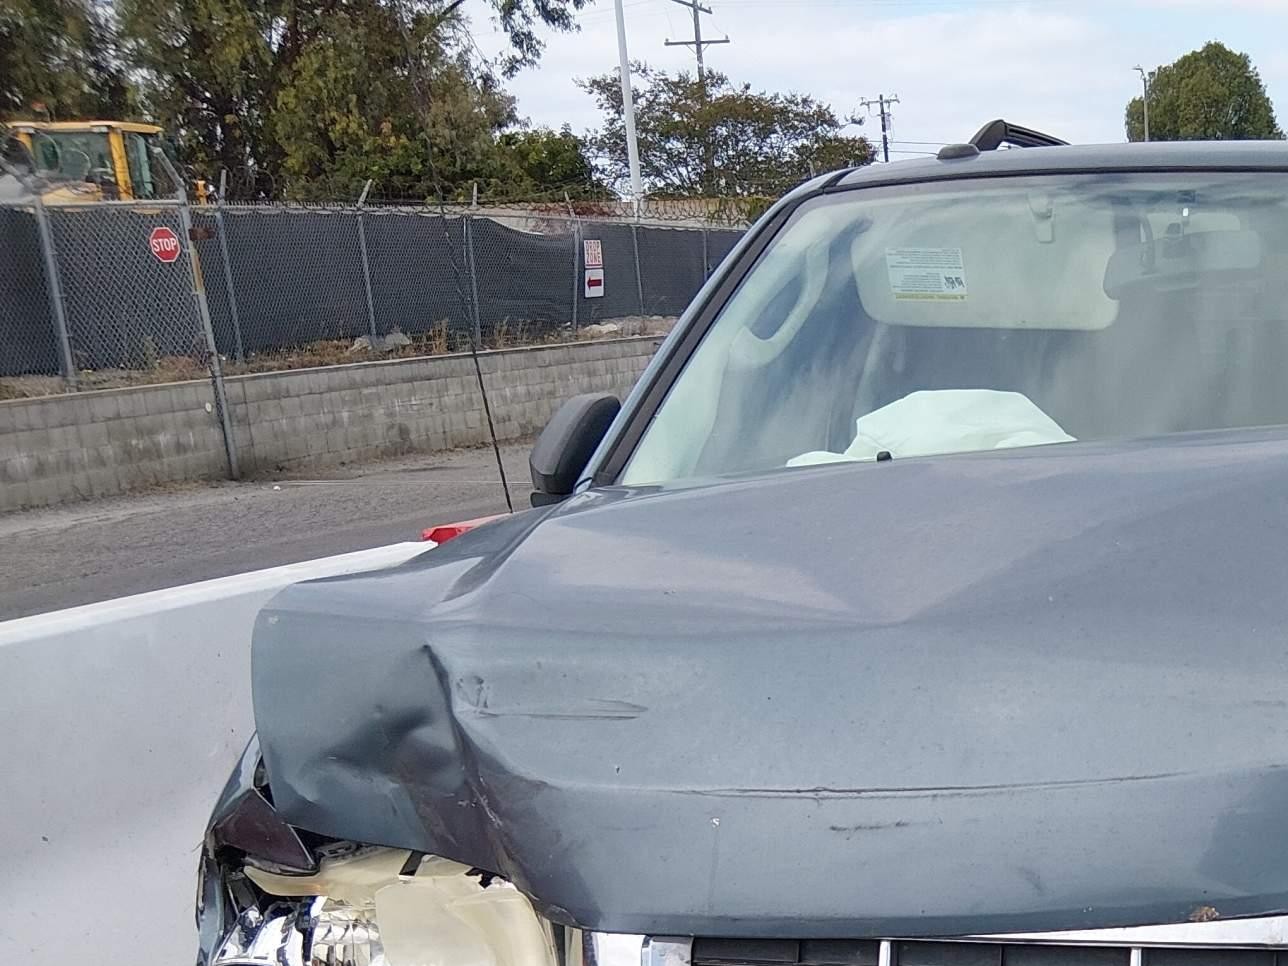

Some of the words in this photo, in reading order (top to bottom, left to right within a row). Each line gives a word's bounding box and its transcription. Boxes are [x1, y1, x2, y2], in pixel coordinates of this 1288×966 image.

[152, 237, 177, 252] STOP
[585, 240, 600, 252] DROP
[586, 252, 602, 264] ZONE
